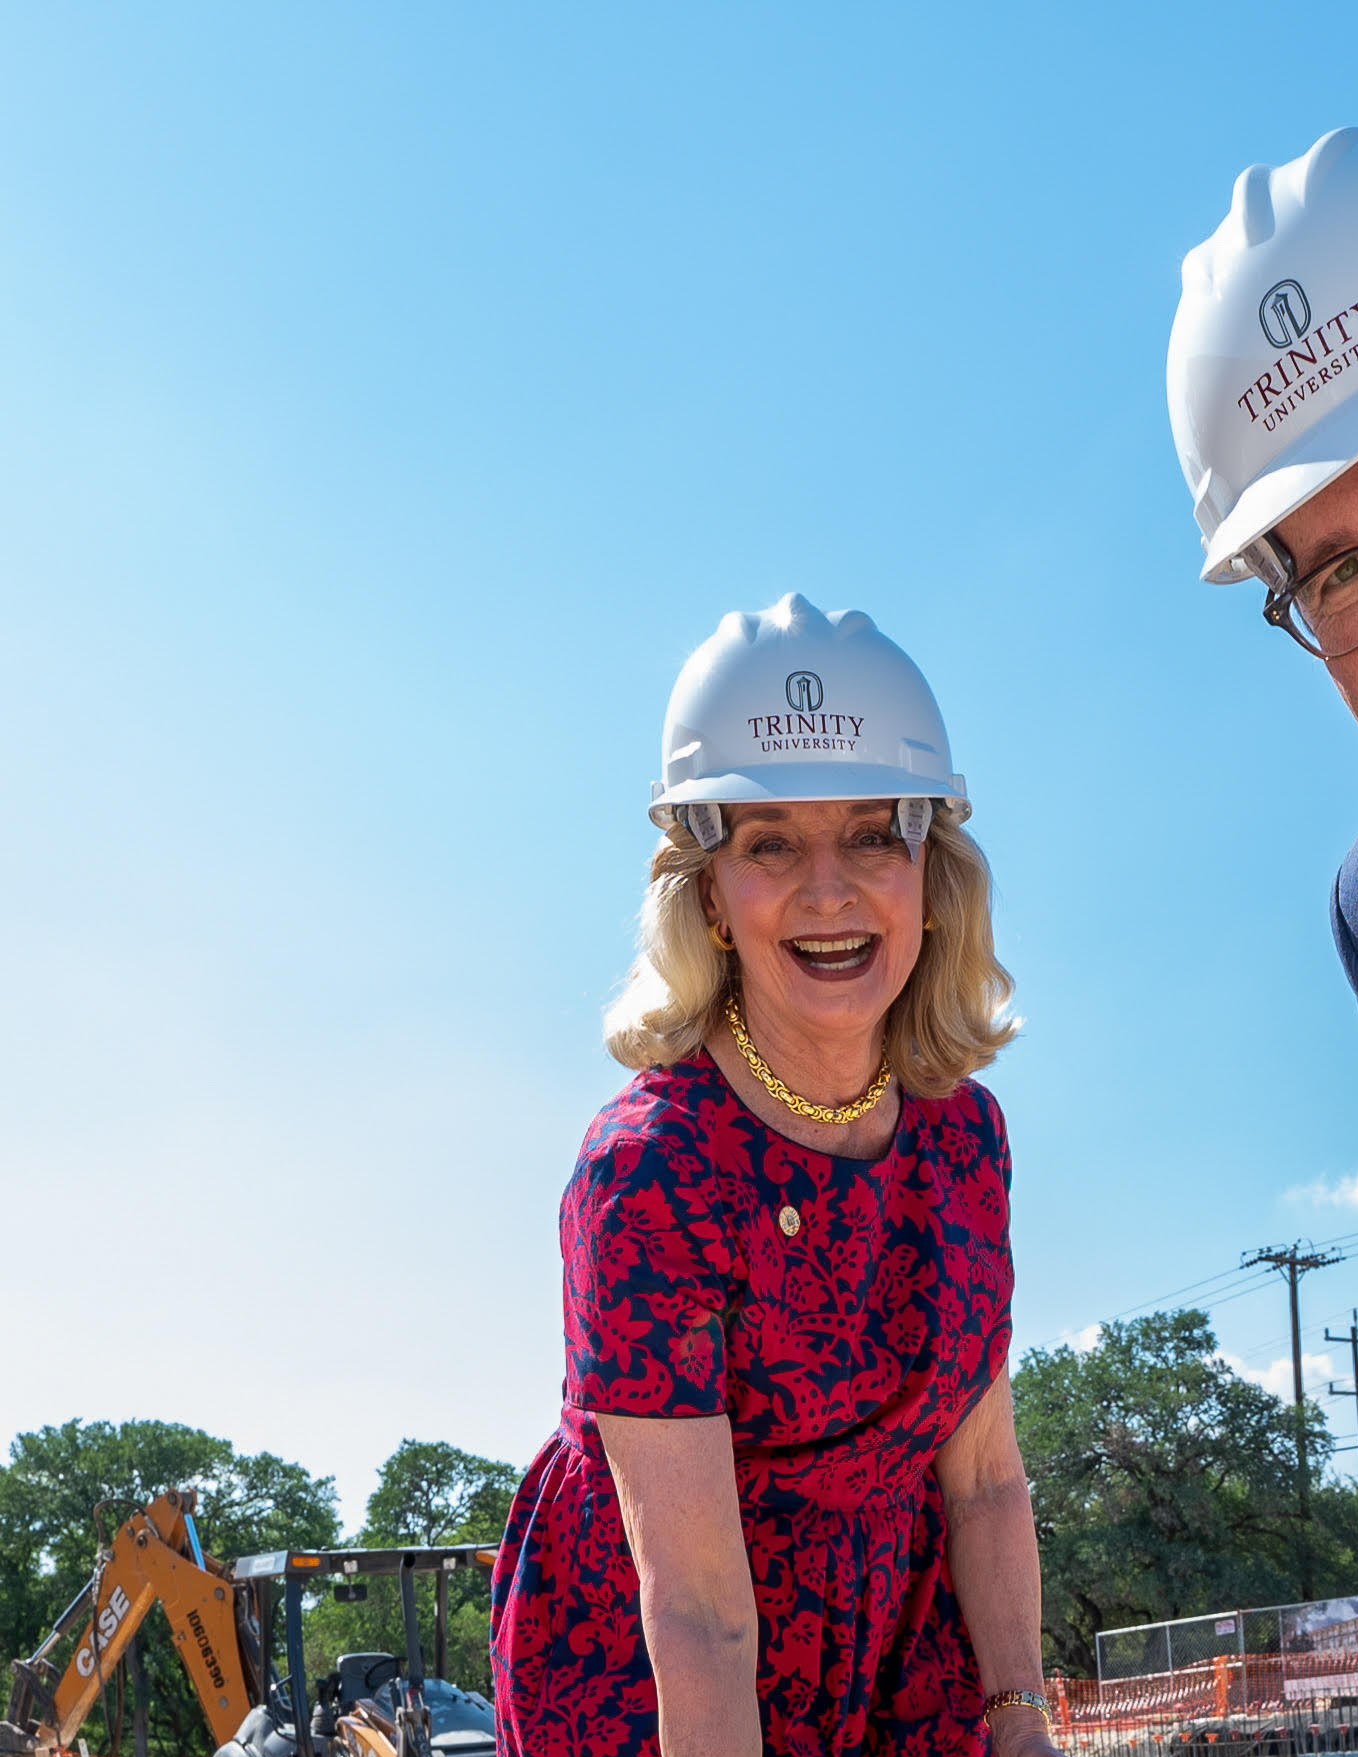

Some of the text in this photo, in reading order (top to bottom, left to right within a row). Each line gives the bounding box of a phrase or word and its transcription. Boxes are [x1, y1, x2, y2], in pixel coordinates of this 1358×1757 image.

[748, 713, 865, 739] TRINITY
[761, 738, 857, 753] UNIVERSITY
[75, 1585, 131, 1677] CASE
